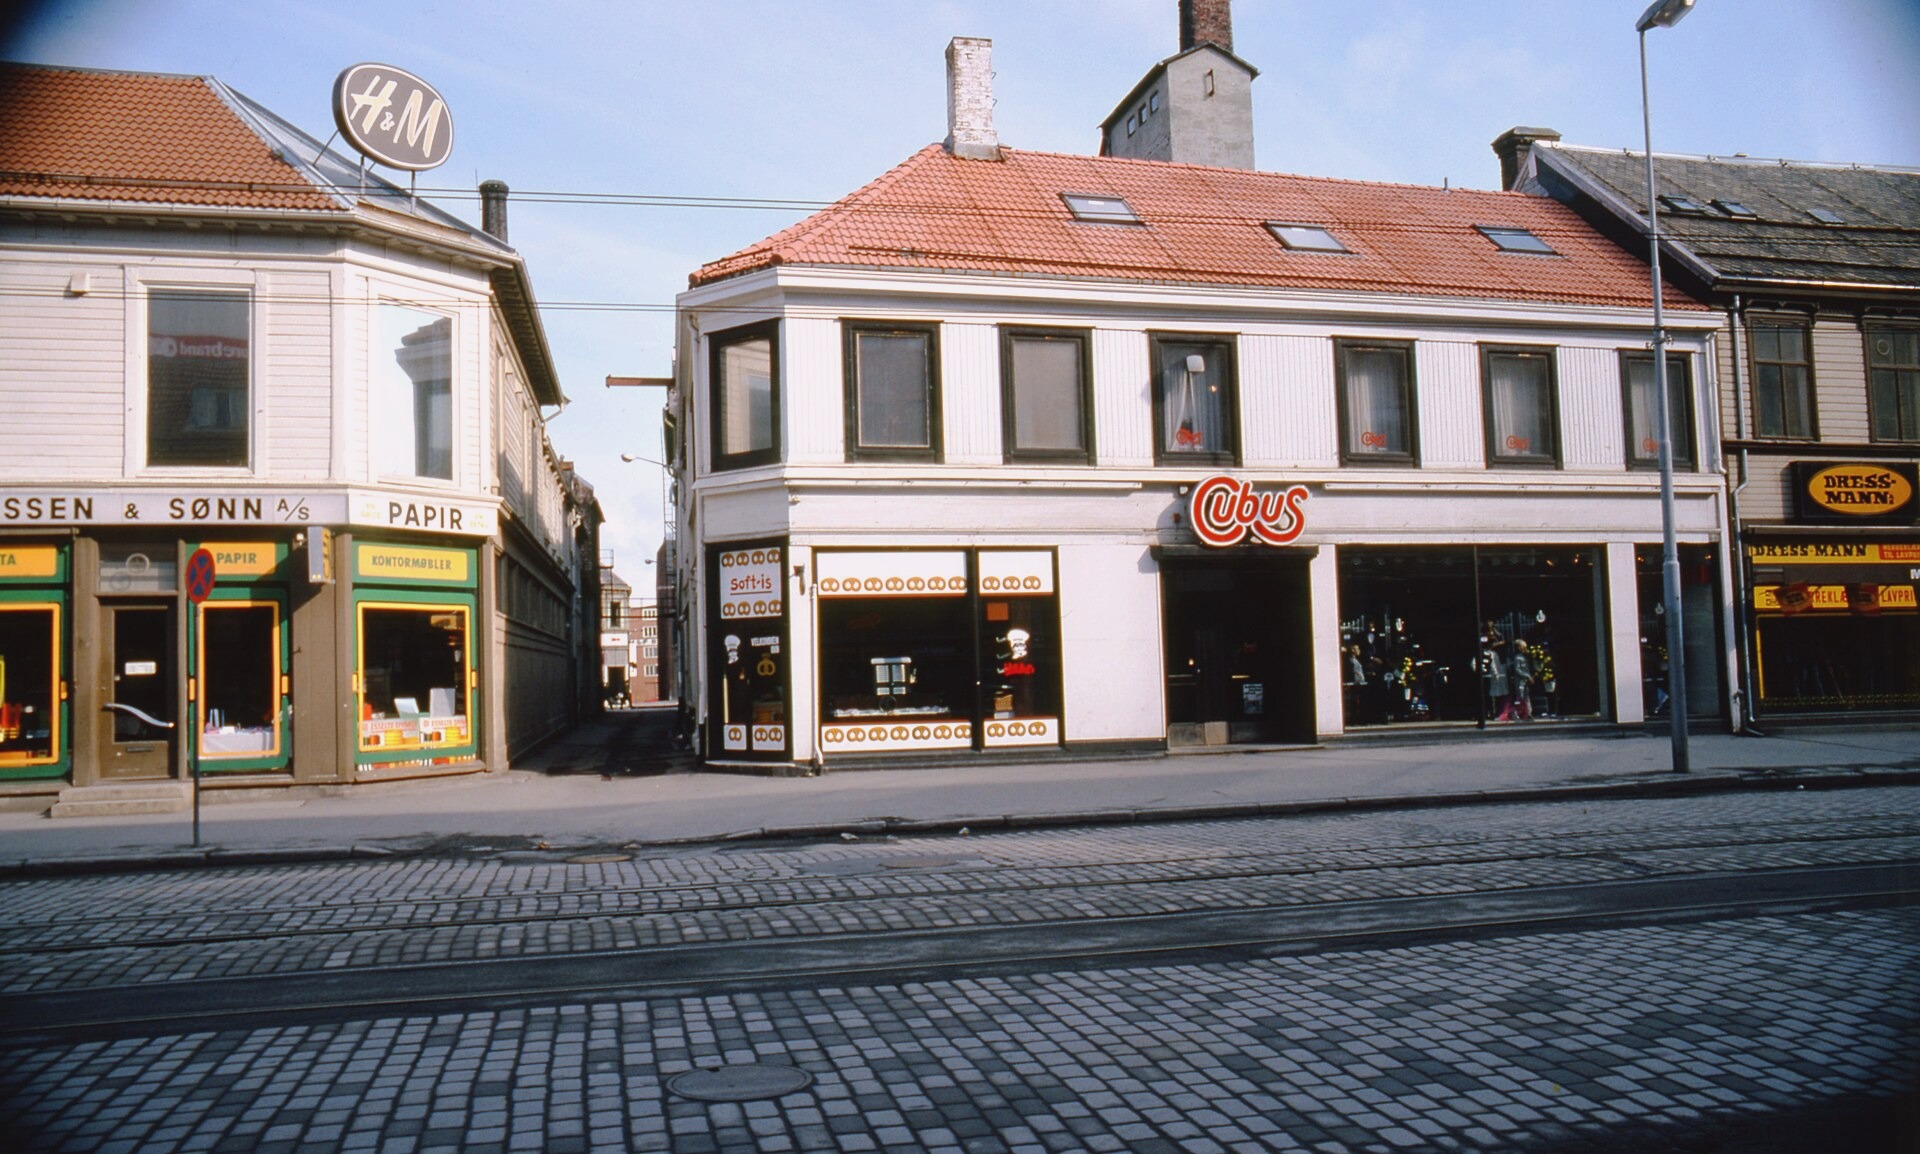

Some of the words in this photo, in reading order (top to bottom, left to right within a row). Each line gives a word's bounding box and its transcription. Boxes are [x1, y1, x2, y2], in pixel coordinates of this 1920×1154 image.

[350, 75, 443, 158] H&M
[1824, 473, 1896, 489] DRESS-
[4, 498, 93, 520] SSEN
[124, 503, 140, 519] &
[169, 497, 262, 520] SØNN
[277, 498, 310, 521] A/S
[389, 501, 463, 530] PAPIR
[1191, 476, 1309, 546] Cubus
[216, 552, 257, 564] PAPIR
[371, 554, 452, 571] KONTORMØBLER
